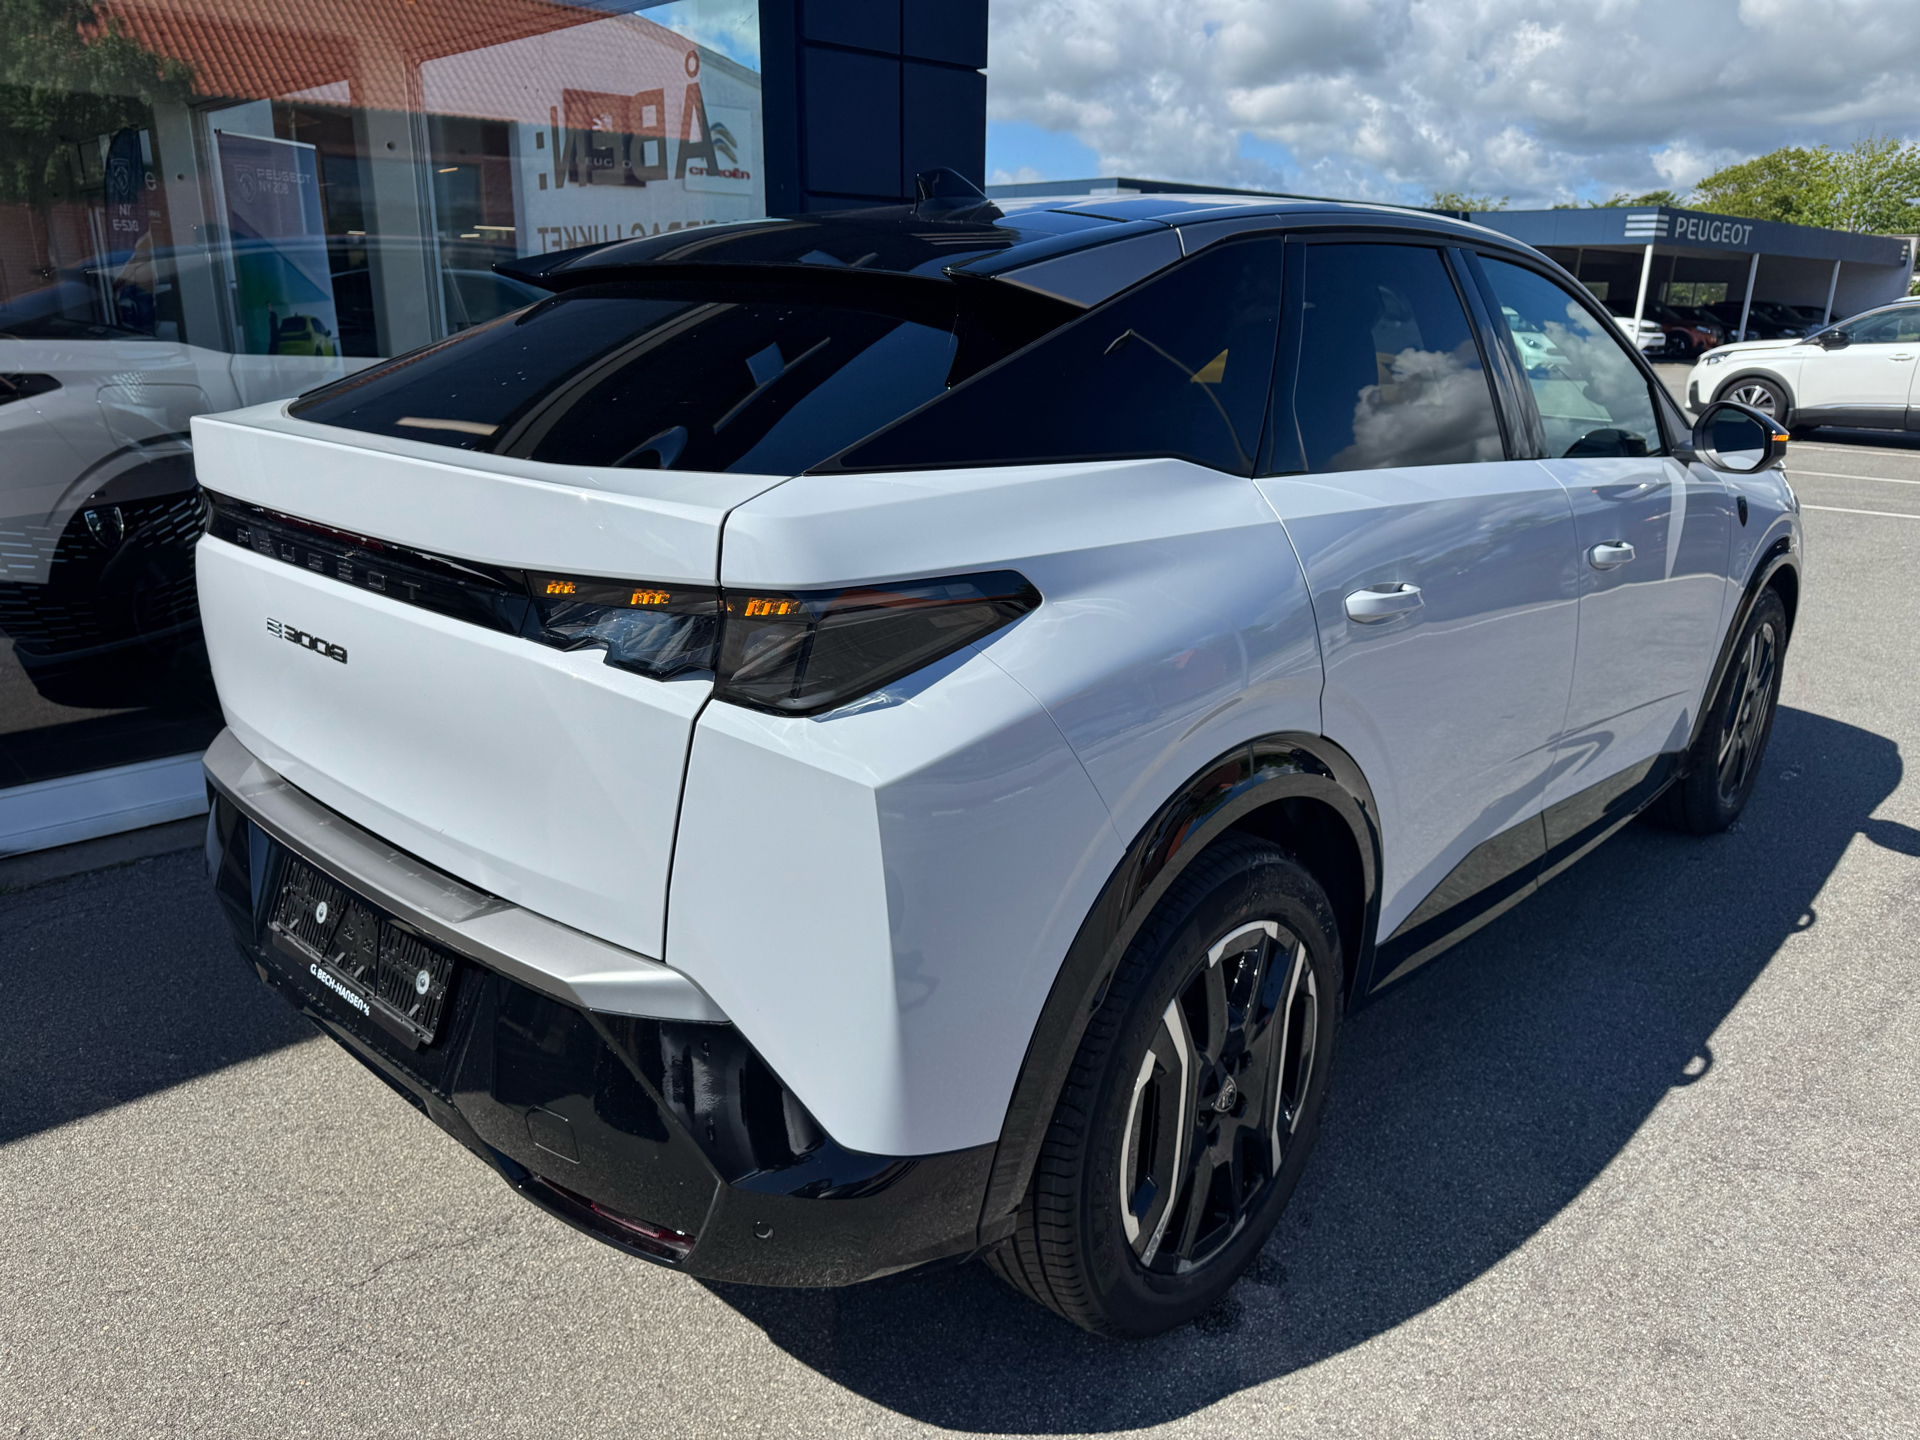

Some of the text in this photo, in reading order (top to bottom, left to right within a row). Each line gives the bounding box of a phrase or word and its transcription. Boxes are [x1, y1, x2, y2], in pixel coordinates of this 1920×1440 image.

[256, 168, 311, 184] PEUGEOT
[258, 182, 290, 195] NY 208
[1674, 216, 1753, 246] PEUGEOT
[237, 528, 421, 600] PEUGEOT
